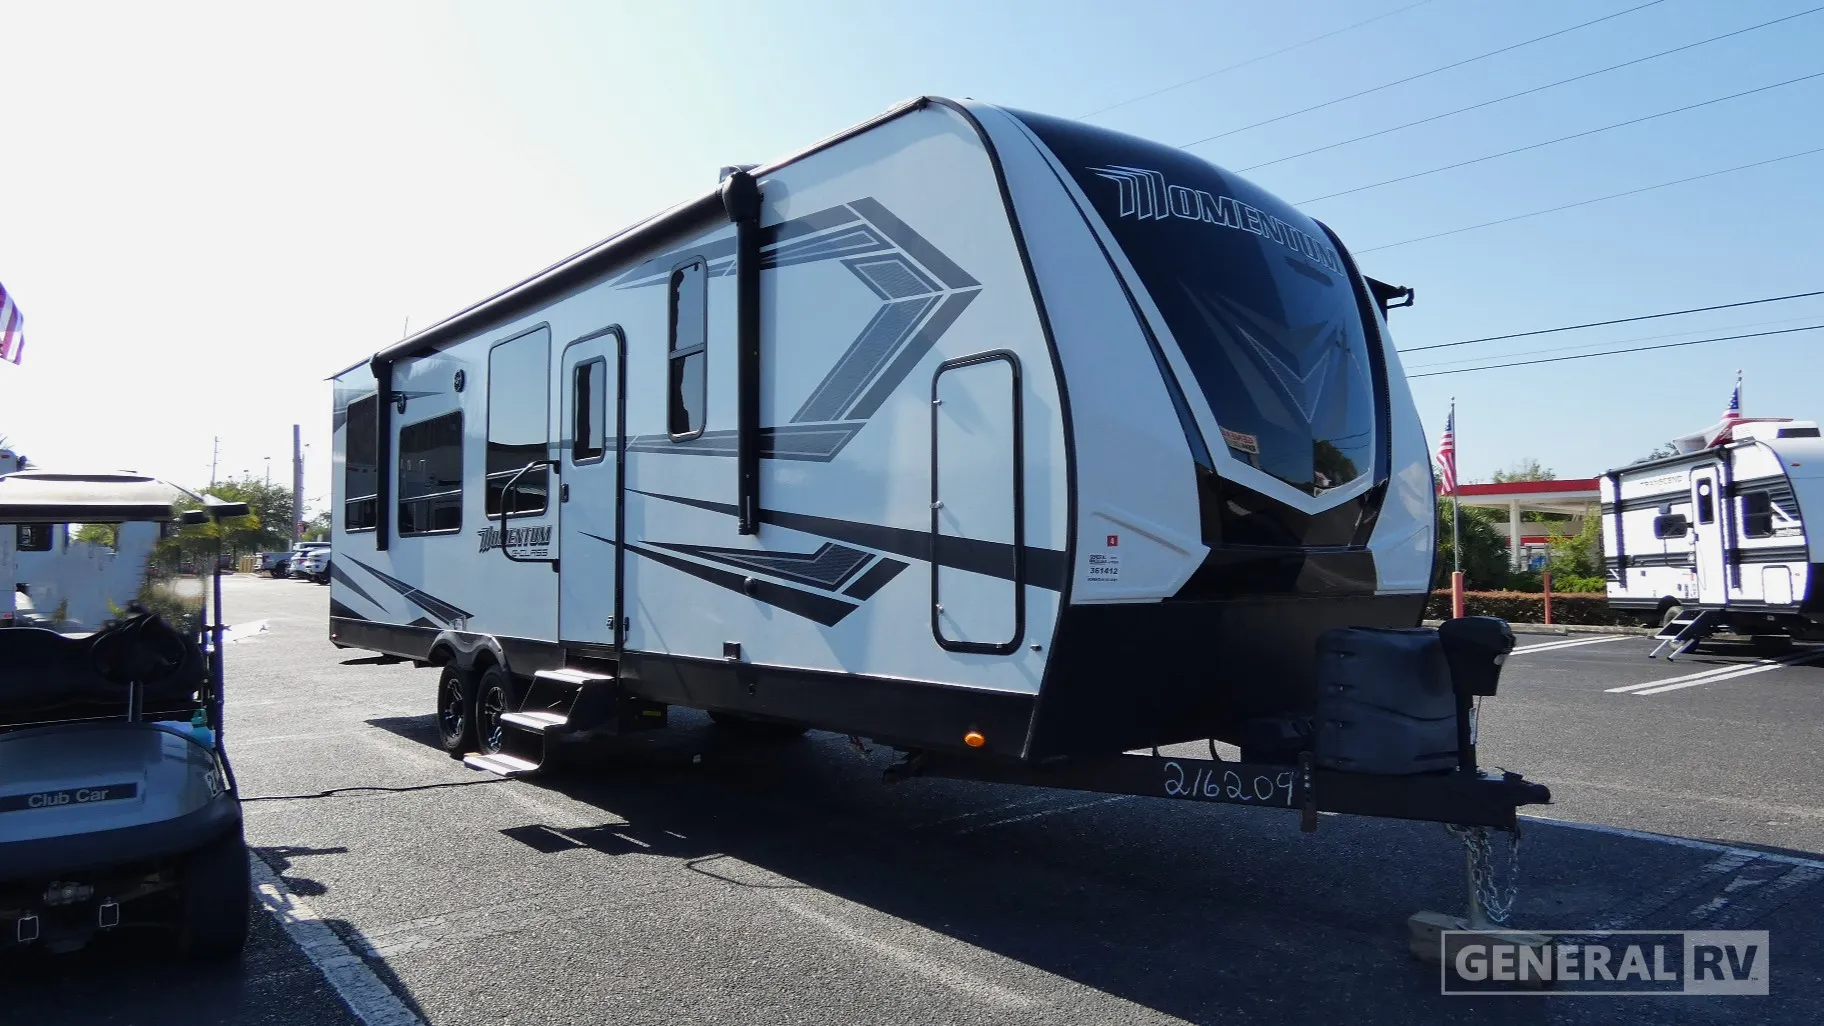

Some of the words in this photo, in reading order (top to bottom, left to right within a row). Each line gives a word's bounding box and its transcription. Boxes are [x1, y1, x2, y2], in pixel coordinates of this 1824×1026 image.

[1085, 165, 1346, 277] MOMENTUM
[477, 525, 552, 553] MOENTUM
[28, 792, 70, 808] Club
[76, 788, 109, 803] Car
[1164, 761, 1294, 806] 216209
